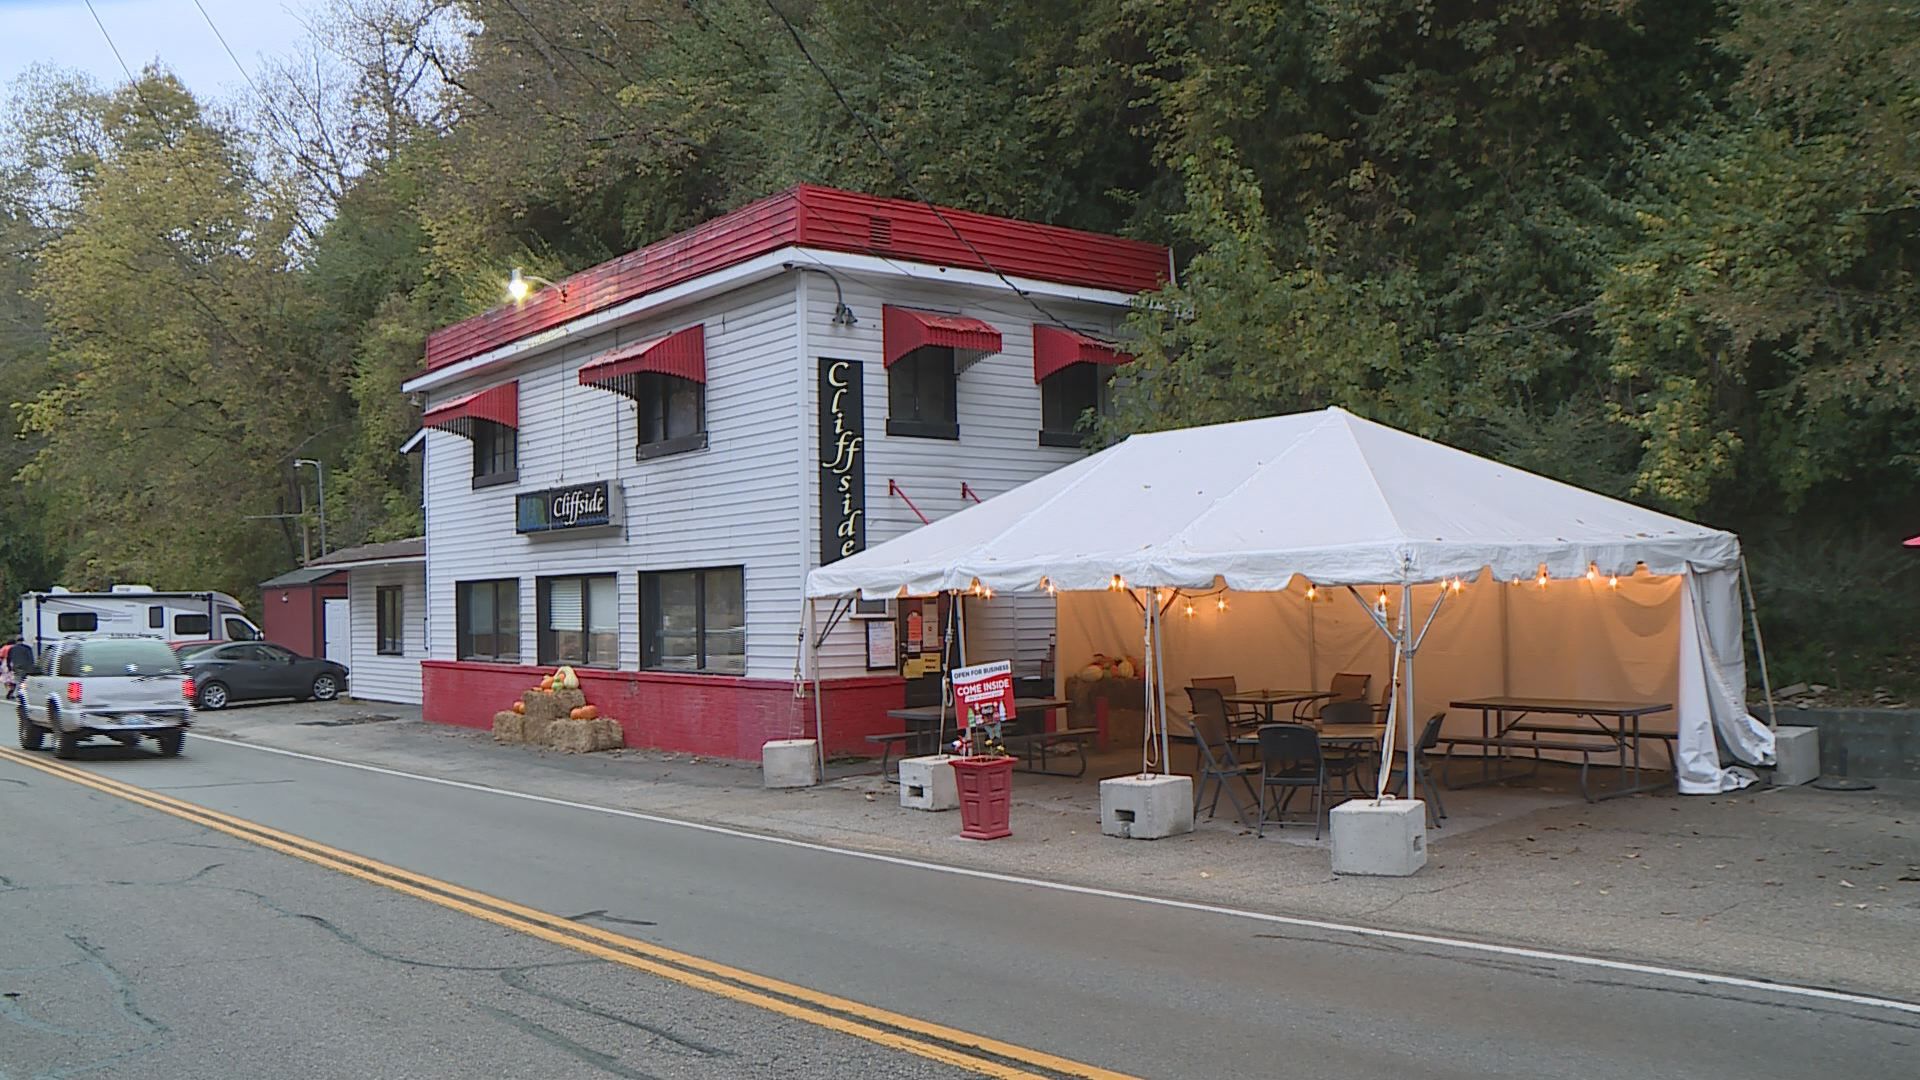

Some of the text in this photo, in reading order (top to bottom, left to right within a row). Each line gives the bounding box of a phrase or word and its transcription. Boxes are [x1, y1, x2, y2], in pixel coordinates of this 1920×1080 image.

[821, 361, 863, 557] Cliffside
[553, 487, 604, 525] Cliffside
[954, 671, 970, 679] OPEN
[983, 664, 1009, 674] BUSINESS
[957, 678, 1010, 696] COME INSIDE
